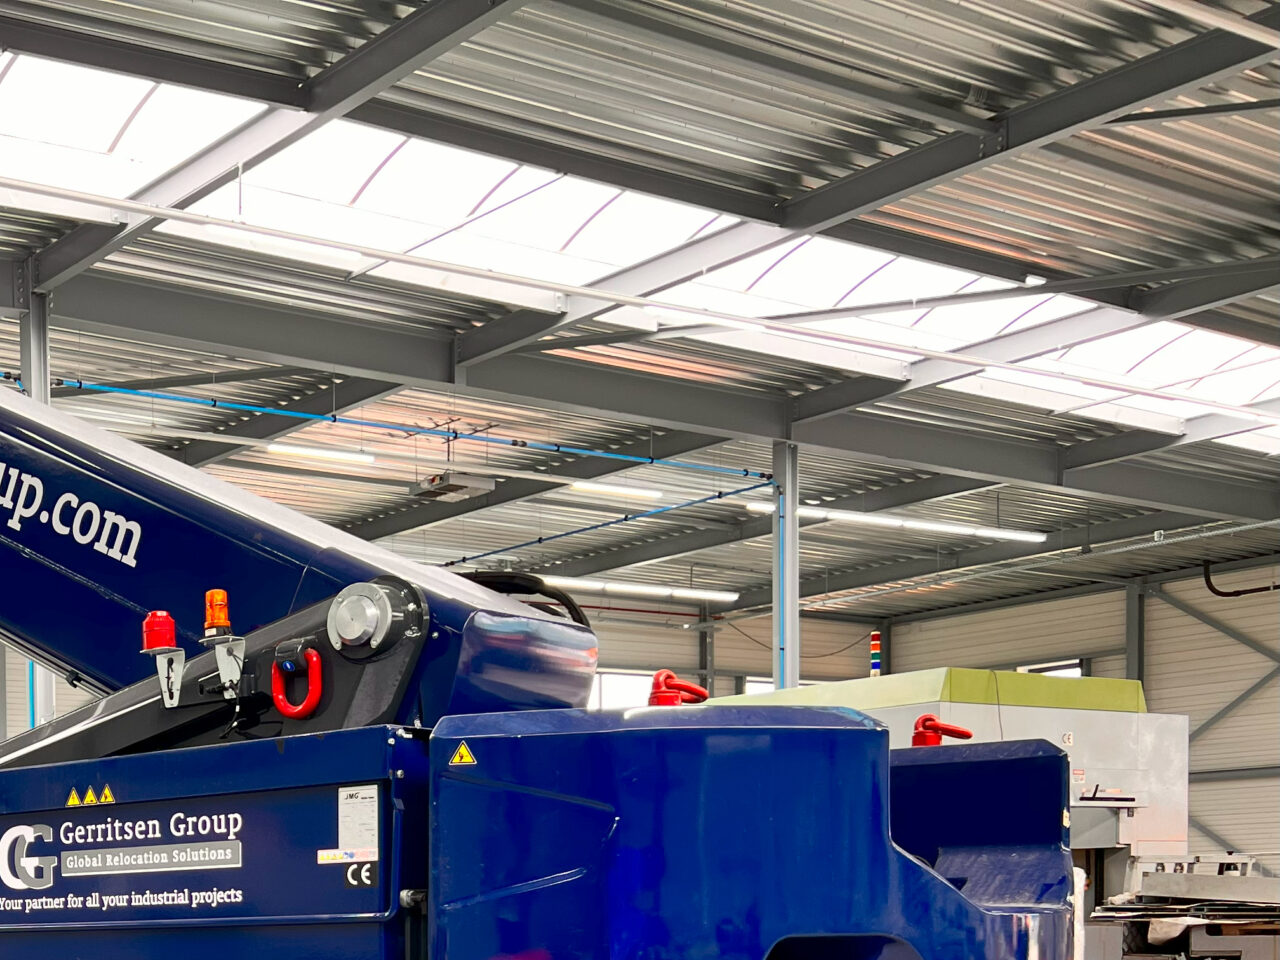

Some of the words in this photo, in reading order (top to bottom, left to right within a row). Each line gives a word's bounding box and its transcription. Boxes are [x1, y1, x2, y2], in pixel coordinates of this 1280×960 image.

[59, 817, 161, 845] Gerritsen
[170, 812, 243, 840] Group
[66, 855, 102, 869] Global
[106, 851, 169, 866] Relocation
[172, 847, 232, 863] Solutions
[347, 863, 372, 885] CE
[25, 895, 65, 913] partner
[67, 894, 84, 909] for
[85, 893, 100, 908] all
[102, 892, 129, 911] your
[131, 889, 189, 906] industrial
[191, 887, 243, 908] projects
